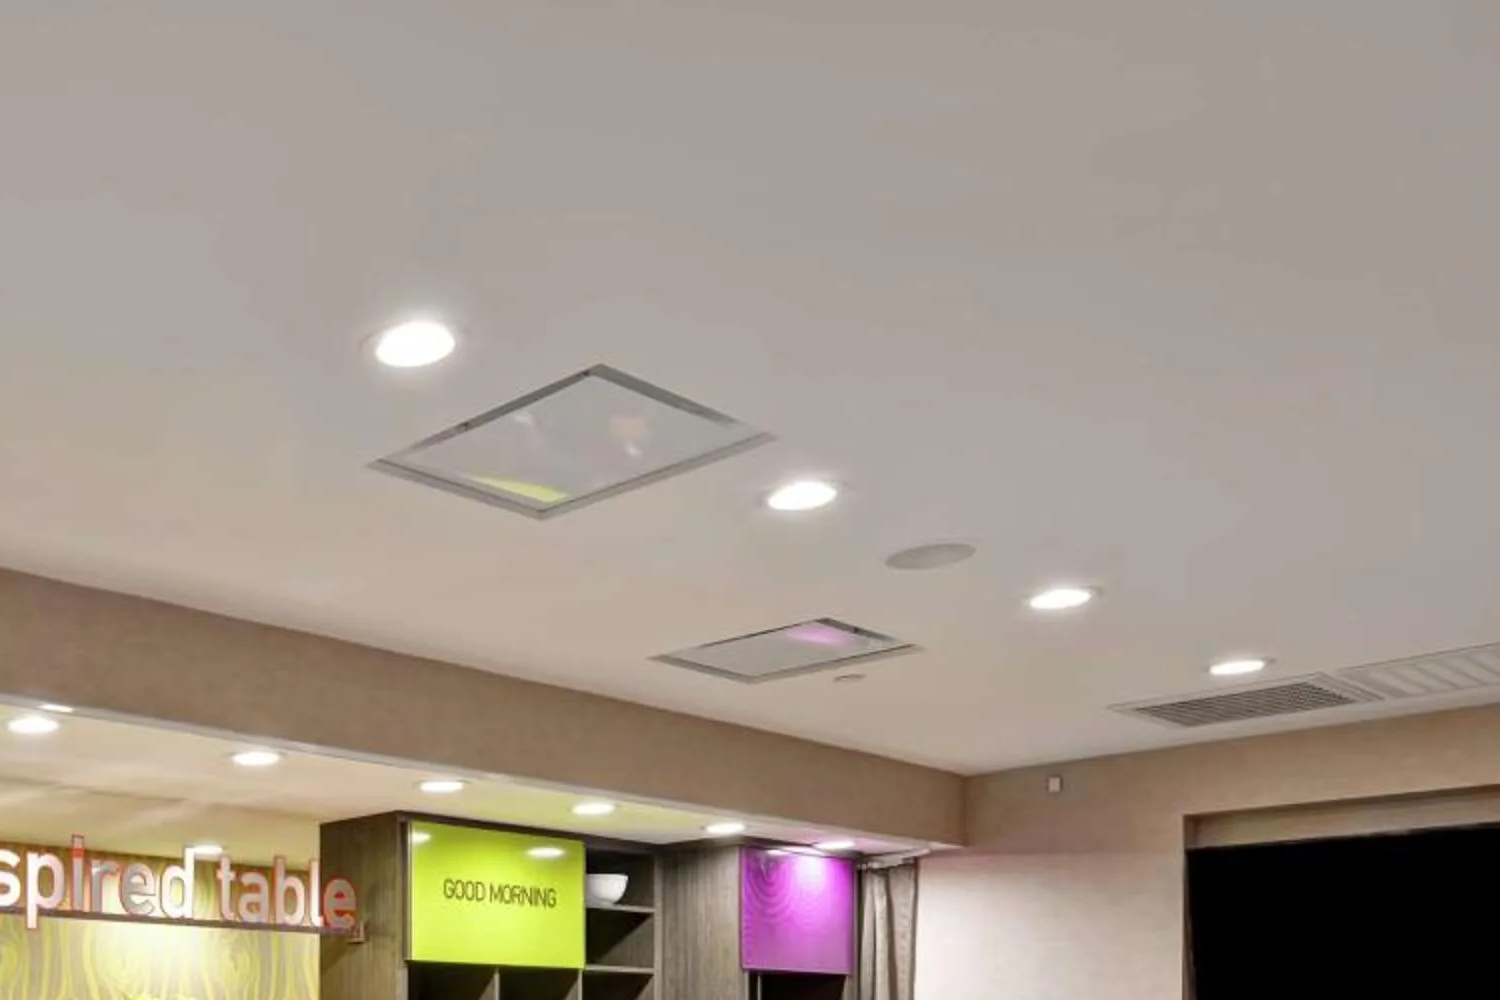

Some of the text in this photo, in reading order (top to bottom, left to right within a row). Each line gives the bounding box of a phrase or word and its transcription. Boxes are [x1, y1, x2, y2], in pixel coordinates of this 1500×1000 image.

[216, 855, 357, 929] table
[443, 878, 558, 909] GOOD MORNING
